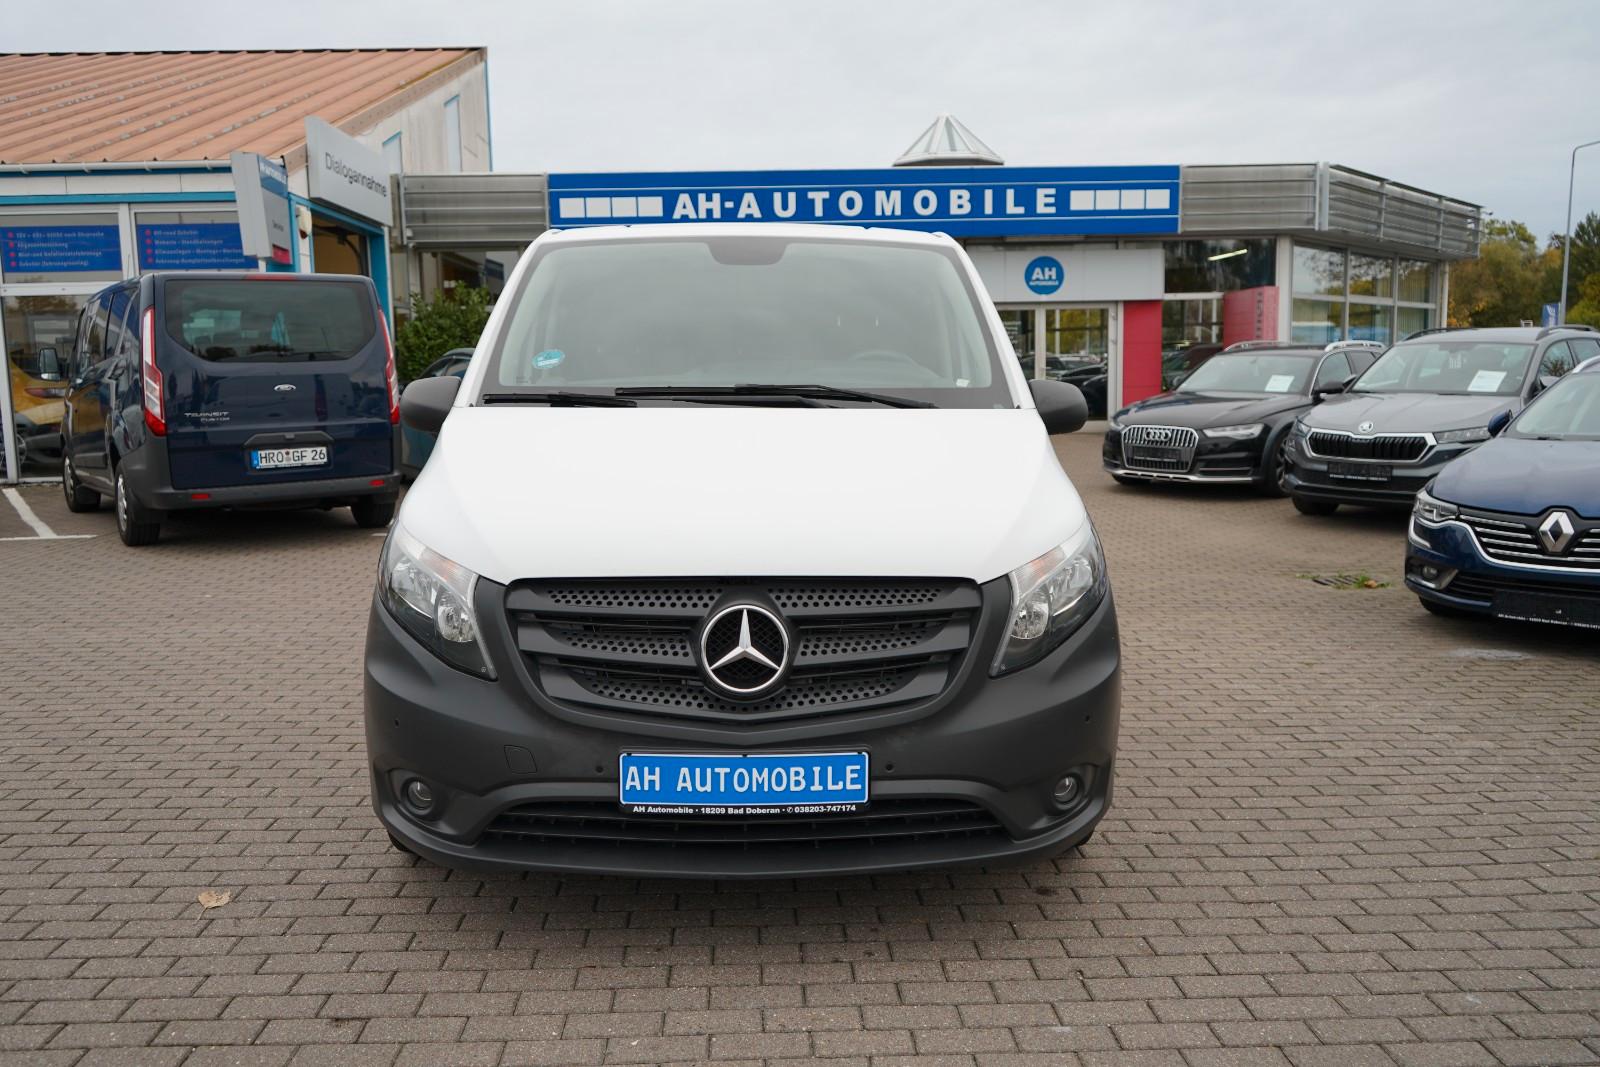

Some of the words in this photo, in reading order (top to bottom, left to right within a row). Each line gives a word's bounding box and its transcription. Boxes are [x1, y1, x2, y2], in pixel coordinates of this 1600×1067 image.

[325, 152, 387, 197] Dialogannahme
[1031, 267, 1057, 281] AH
[259, 451, 284, 464] HRO
[292, 450, 307, 462] GF
[311, 449, 326, 461] 26
[625, 766, 661, 791] AH
[676, 765, 862, 793] AUTOMOBILE
[647, 806, 694, 814] Automobile
[727, 807, 744, 815] Bad
[794, 805, 856, 813] 038203-747174
